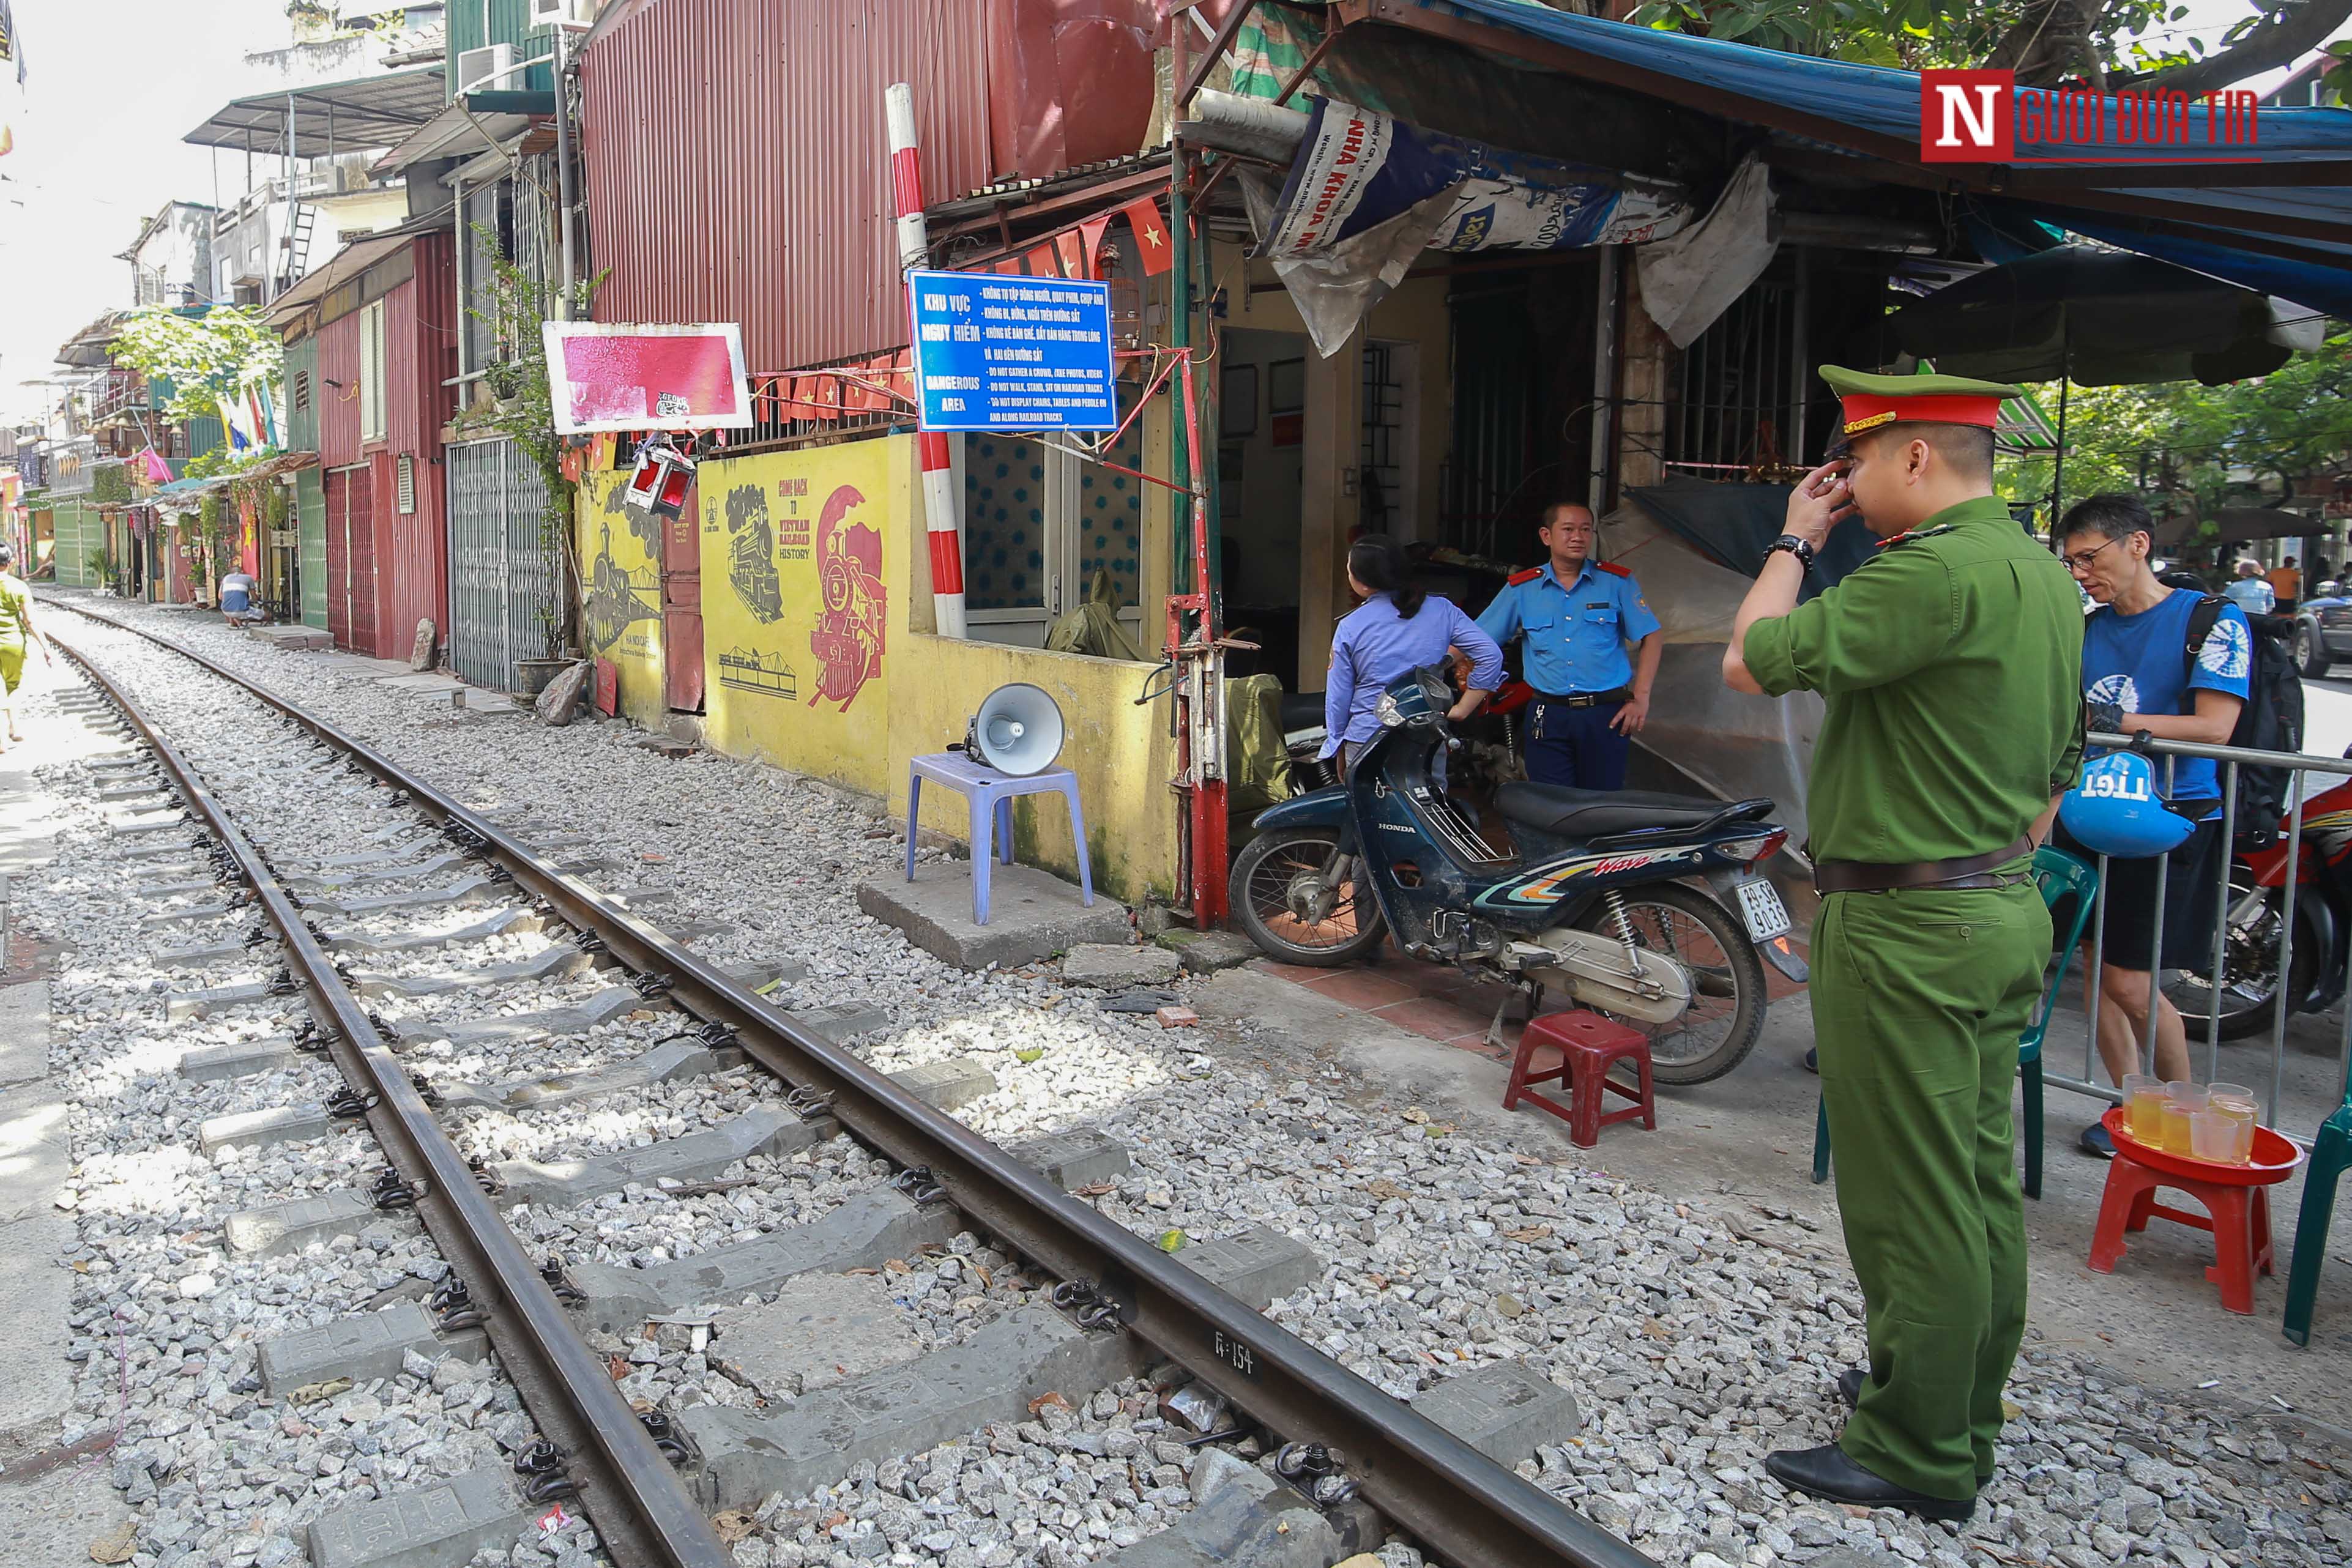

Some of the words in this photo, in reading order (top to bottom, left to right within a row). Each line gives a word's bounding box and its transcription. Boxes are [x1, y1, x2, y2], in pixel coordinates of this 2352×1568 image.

[1336, 119, 1364, 165] NHA
[1308, 171, 1348, 226] KHOA
[1288, 232, 1317, 254] M
[924, 294, 947, 311] KHU
[949, 294, 971, 316] VỰC
[984, 305, 1002, 319] KHÔNG
[921, 324, 951, 341] NGUY
[953, 318, 981, 342] HIỂM
[986, 325, 1004, 339] KHÔNG
[1033, 346, 1043, 362] SẮT
[989, 367, 997, 376] DO
[997, 367, 1008, 377] NOT
[1008, 368, 1028, 377] GATHER
[1029, 368, 1033, 377] A
[1033, 368, 1053, 378] CROWD,
[1054, 368, 1066, 377] TAKE
[1087, 370, 1103, 379] VIDEOS
[926, 376, 980, 390] DANGEROUS
[990, 382, 998, 392] DO
[999, 382, 1009, 392] NOT
[1010, 382, 1026, 393] WALK,
[1027, 383, 1045, 393] STAND,
[1054, 383, 1061, 392] ON
[1062, 383, 1085, 392] RAILROAD
[1085, 384, 1103, 393] TRACKS
[942, 398, 966, 412] AREA
[990, 397, 999, 407] DO
[999, 398, 1010, 407] NOT
[1011, 398, 1032, 407] DISPLAY
[1052, 398, 1071, 407] TABLES
[1071, 398, 1081, 407] AND
[989, 412, 1001, 422] AND
[1002, 412, 1019, 422] ALONG
[1019, 412, 1043, 422] RAILROAD
[1043, 412, 1063, 422] TRACKS
[791, 500, 797, 515] TO
[780, 519, 809, 532] VIETNAM
[780, 549, 809, 559] HISTORY
[2081, 775, 2148, 801] TTGT
[1379, 823, 1416, 833] HONDA
[1594, 856, 1654, 877] Wave
[1754, 904, 1787, 934] 9036
